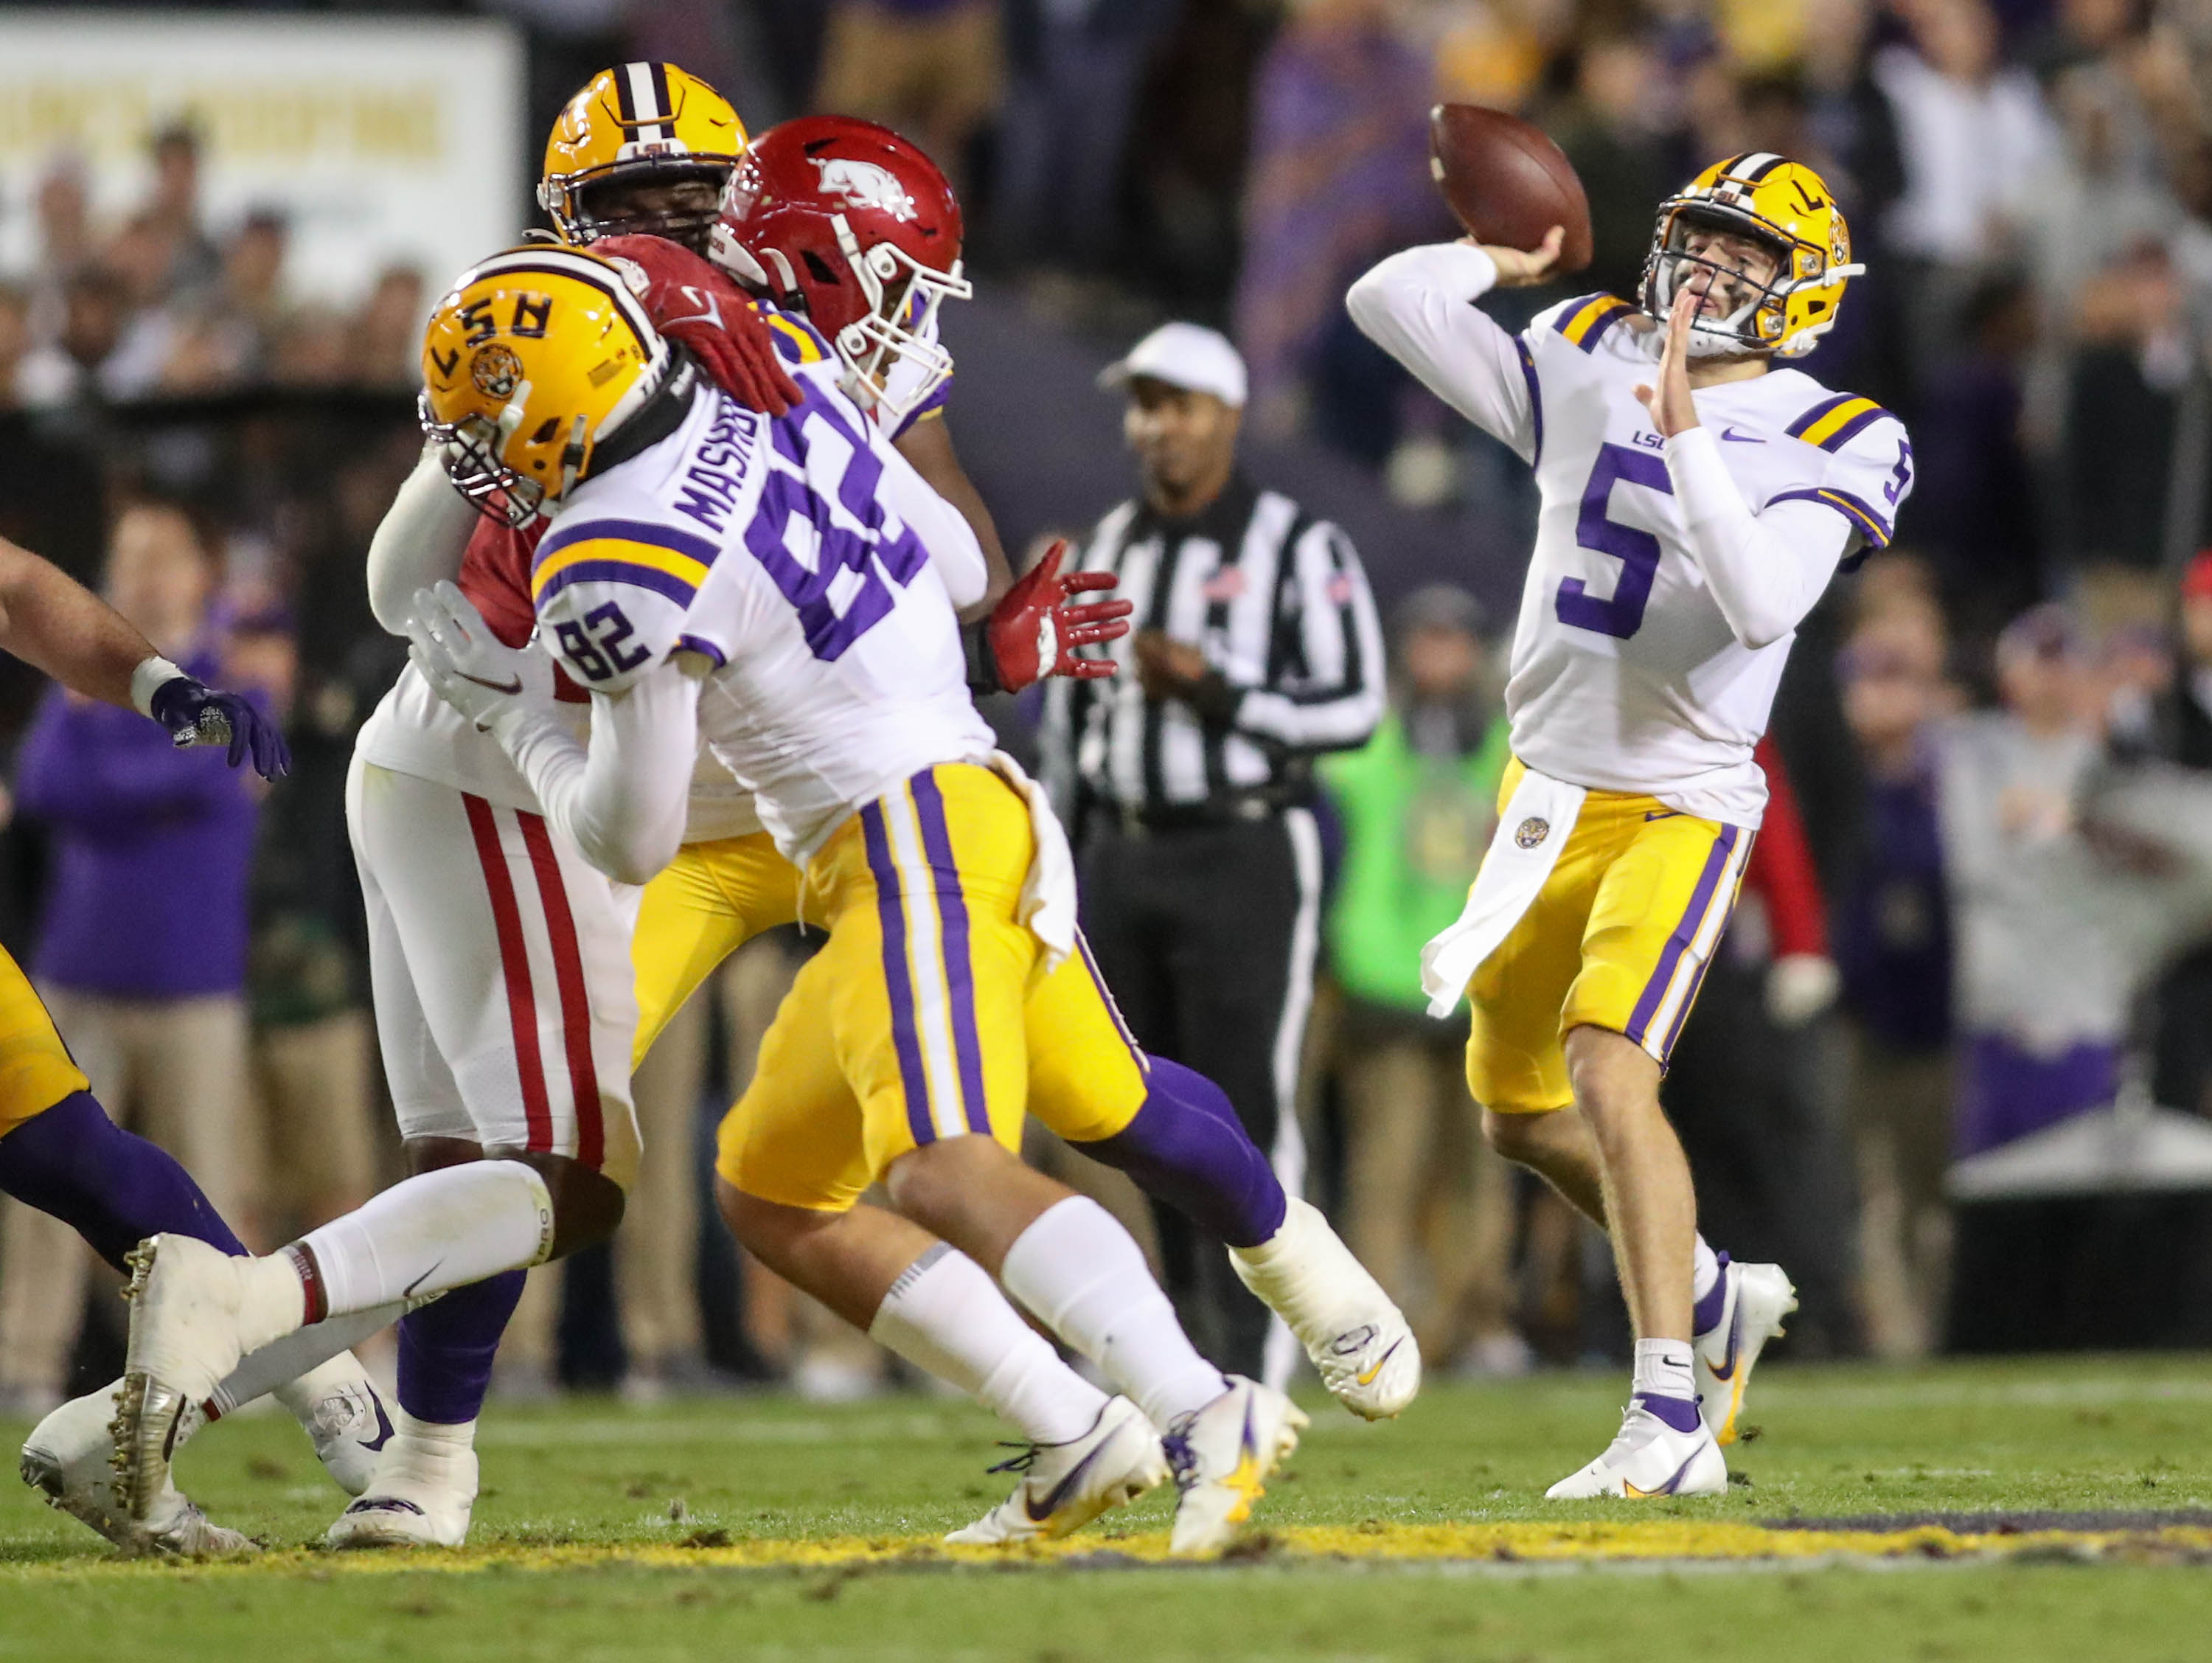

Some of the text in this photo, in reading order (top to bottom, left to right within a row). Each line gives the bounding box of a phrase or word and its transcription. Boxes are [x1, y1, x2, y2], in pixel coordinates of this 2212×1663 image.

[744, 372, 929, 662] 82
[1555, 441, 1674, 640] 5
[554, 600, 653, 681] 82
